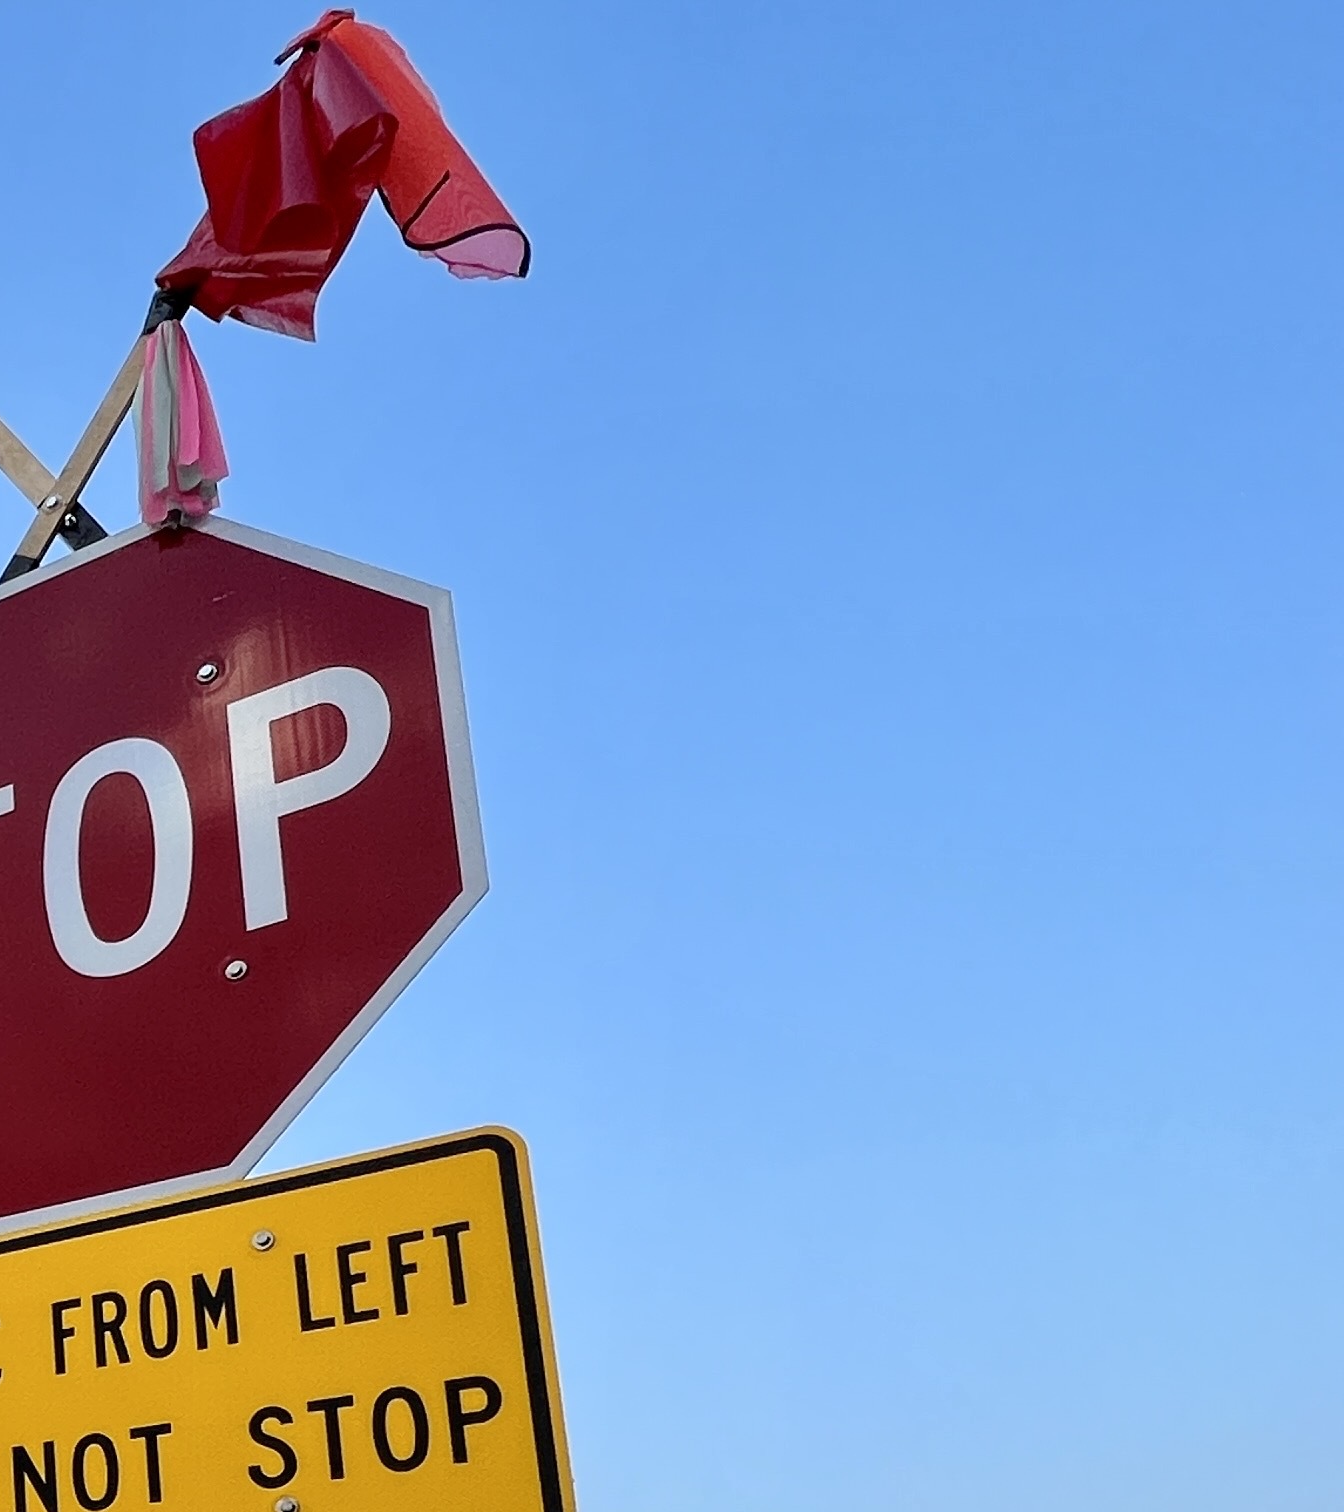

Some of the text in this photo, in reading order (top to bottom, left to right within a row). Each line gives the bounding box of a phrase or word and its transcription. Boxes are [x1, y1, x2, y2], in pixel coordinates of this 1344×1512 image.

[52, 1267, 240, 1376] FROM
[294, 1221, 473, 1333] LEFT
[247, 1376, 503, 1489] STOP
